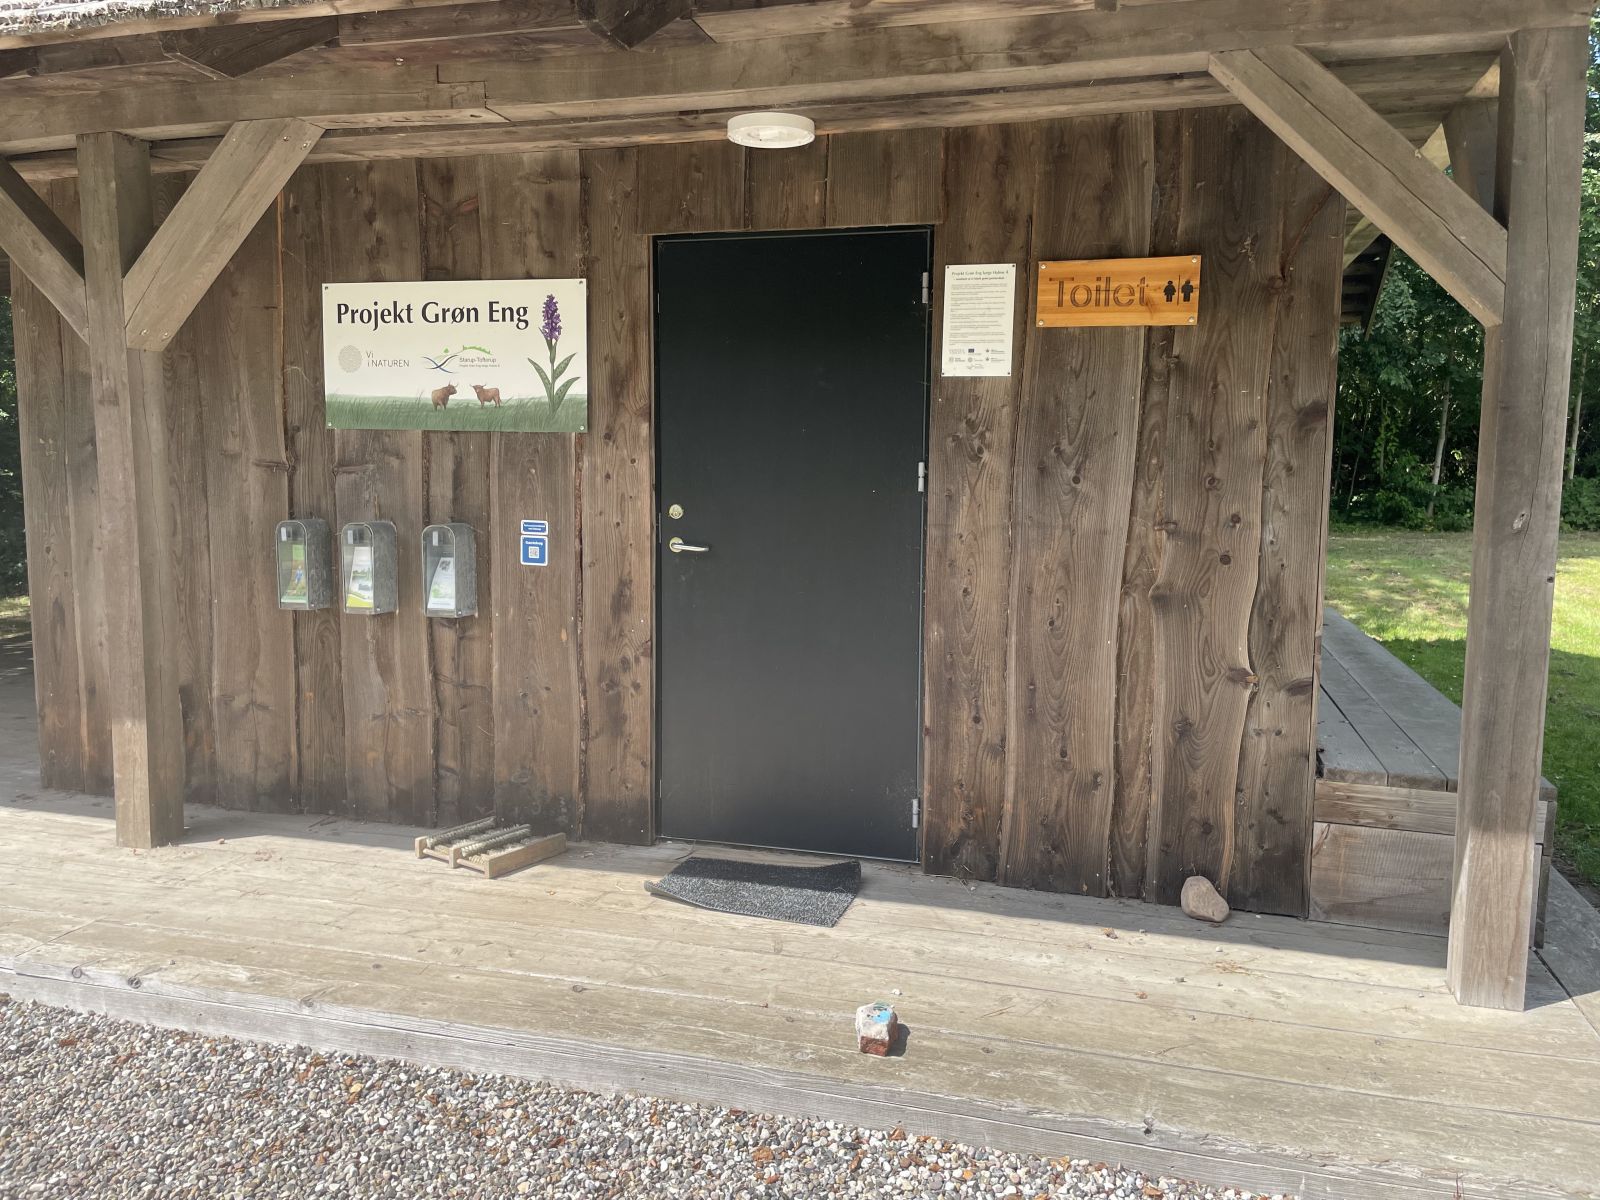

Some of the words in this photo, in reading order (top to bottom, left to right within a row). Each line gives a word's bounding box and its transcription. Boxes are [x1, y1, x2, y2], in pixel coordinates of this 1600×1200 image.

[1048, 275, 1149, 308] Toilet
[336, 300, 414, 331] Projekt
[421, 301, 479, 325] Grøn
[488, 300, 529, 331] Eng
[366, 350, 374, 359] Vi
[371, 359, 410, 368] NATUREN
